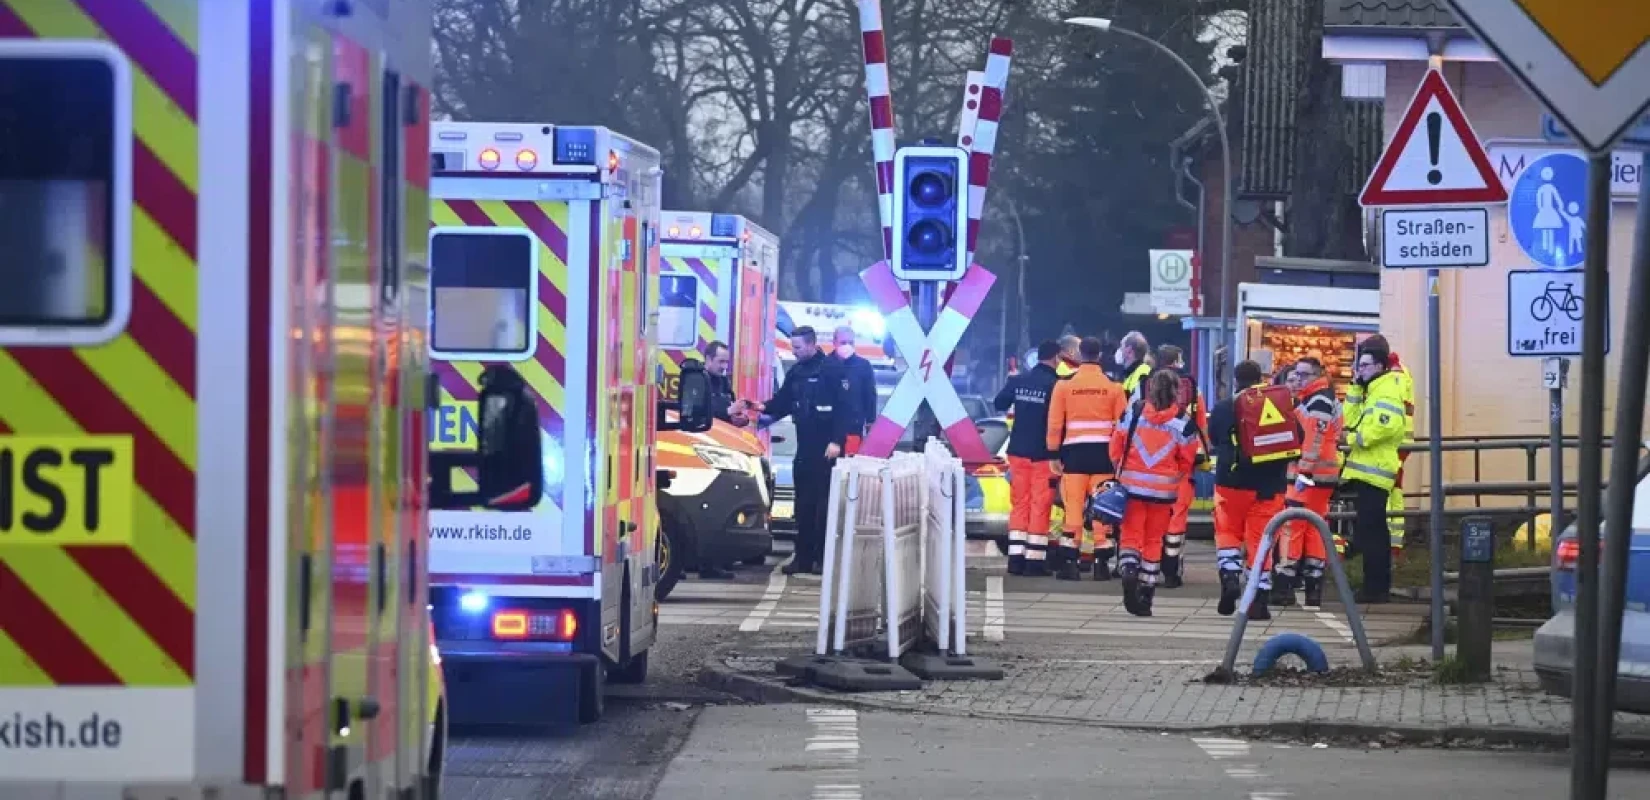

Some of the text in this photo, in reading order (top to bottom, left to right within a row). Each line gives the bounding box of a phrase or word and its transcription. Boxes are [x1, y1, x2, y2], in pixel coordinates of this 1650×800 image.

[1397, 218, 1475, 235] Straßen-
[1400, 241, 1473, 258] schäden
[1544, 327, 1576, 345] frei
